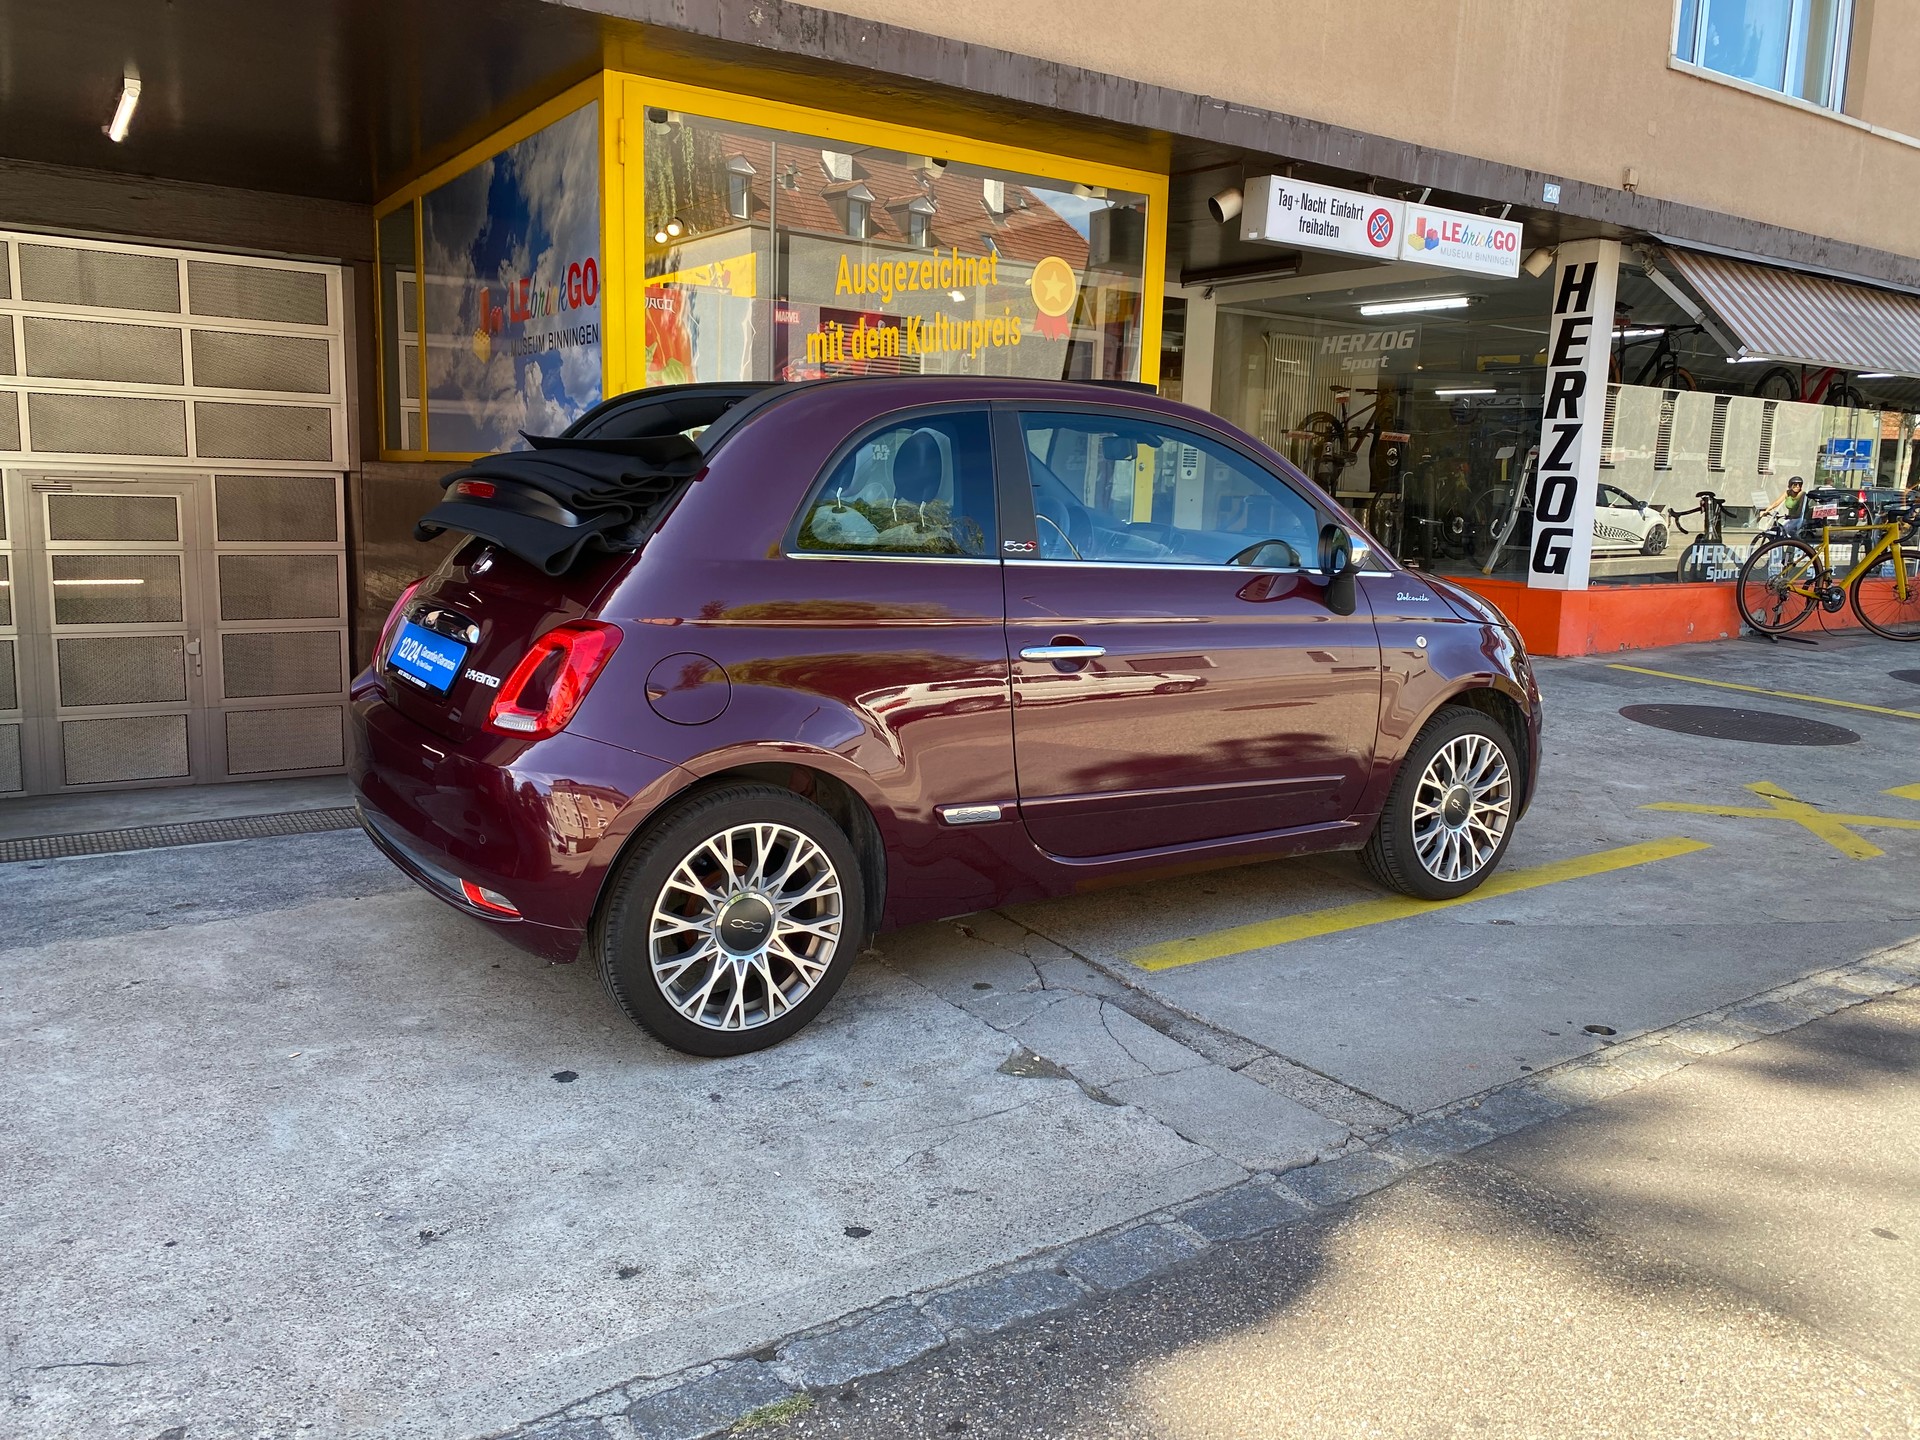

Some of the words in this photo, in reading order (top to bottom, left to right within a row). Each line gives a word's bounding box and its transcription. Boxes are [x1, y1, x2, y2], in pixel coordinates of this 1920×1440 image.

[1547, 186, 1558, 200] 20
[1330, 198, 1364, 221] Einfahrt
[1298, 216, 1340, 238] freihalten
[1441, 220, 1516, 252] LEbrickGO
[1440, 246, 1473, 260] MUSEUM
[1475, 252, 1514, 267] BINNINGEN
[835, 247, 998, 303] Ausgezeichnet
[509, 257, 598, 323] LEbrickGO
[775, 310, 800, 324] MARVEL
[510, 333, 545, 358] MUSEUM
[548, 322, 599, 351] BINNINGEN
[807, 320, 845, 364] mit
[852, 317, 899, 360] dem
[907, 307, 1022, 360] Kulturpreis
[1320, 329, 1416, 355] HERZOG
[1341, 355, 1390, 373] Sport
[1532, 262, 1597, 576] HERZOG
[1706, 566, 1740, 582] Sport
[1396, 591, 1430, 602] Dolcevita
[397, 636, 423, 664] 12/24
[956, 809, 992, 821] 500
